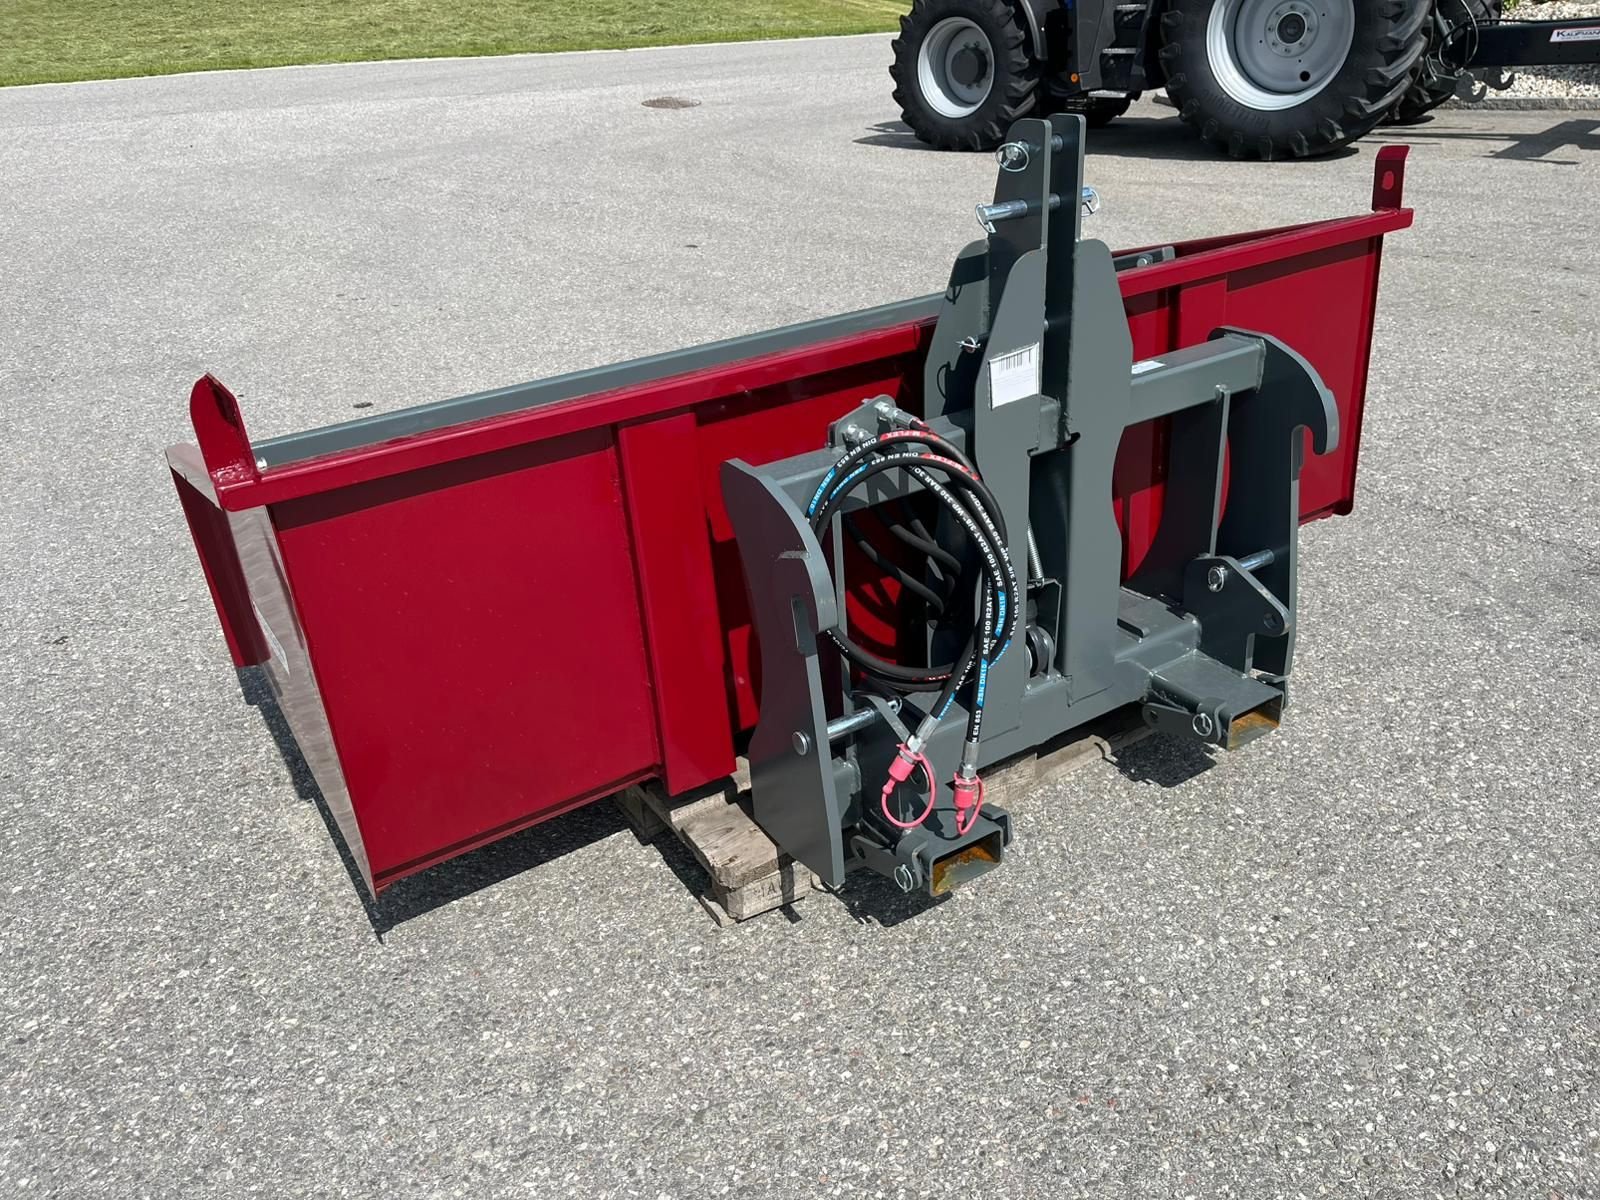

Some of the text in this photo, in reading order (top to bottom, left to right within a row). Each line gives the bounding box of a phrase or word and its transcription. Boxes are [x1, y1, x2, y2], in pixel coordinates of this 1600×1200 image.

[862, 437, 877, 448] DIN
[849, 445, 861, 457] EN
[837, 455, 850, 468] 853
[924, 475, 942, 491] BAR
[940, 489, 954, 503] 330
[952, 502, 964, 516] WP
[963, 515, 977, 531] 3/8"
[982, 511, 995, 530] BAR
[974, 531, 990, 553] R2AT
[992, 531, 1003, 546] 330
[987, 553, 997, 568] 100
[1000, 547, 1009, 562] WP
[993, 569, 1003, 587] SAE
[972, 724, 980, 736] EN
[983, 638, 991, 655] SAE
